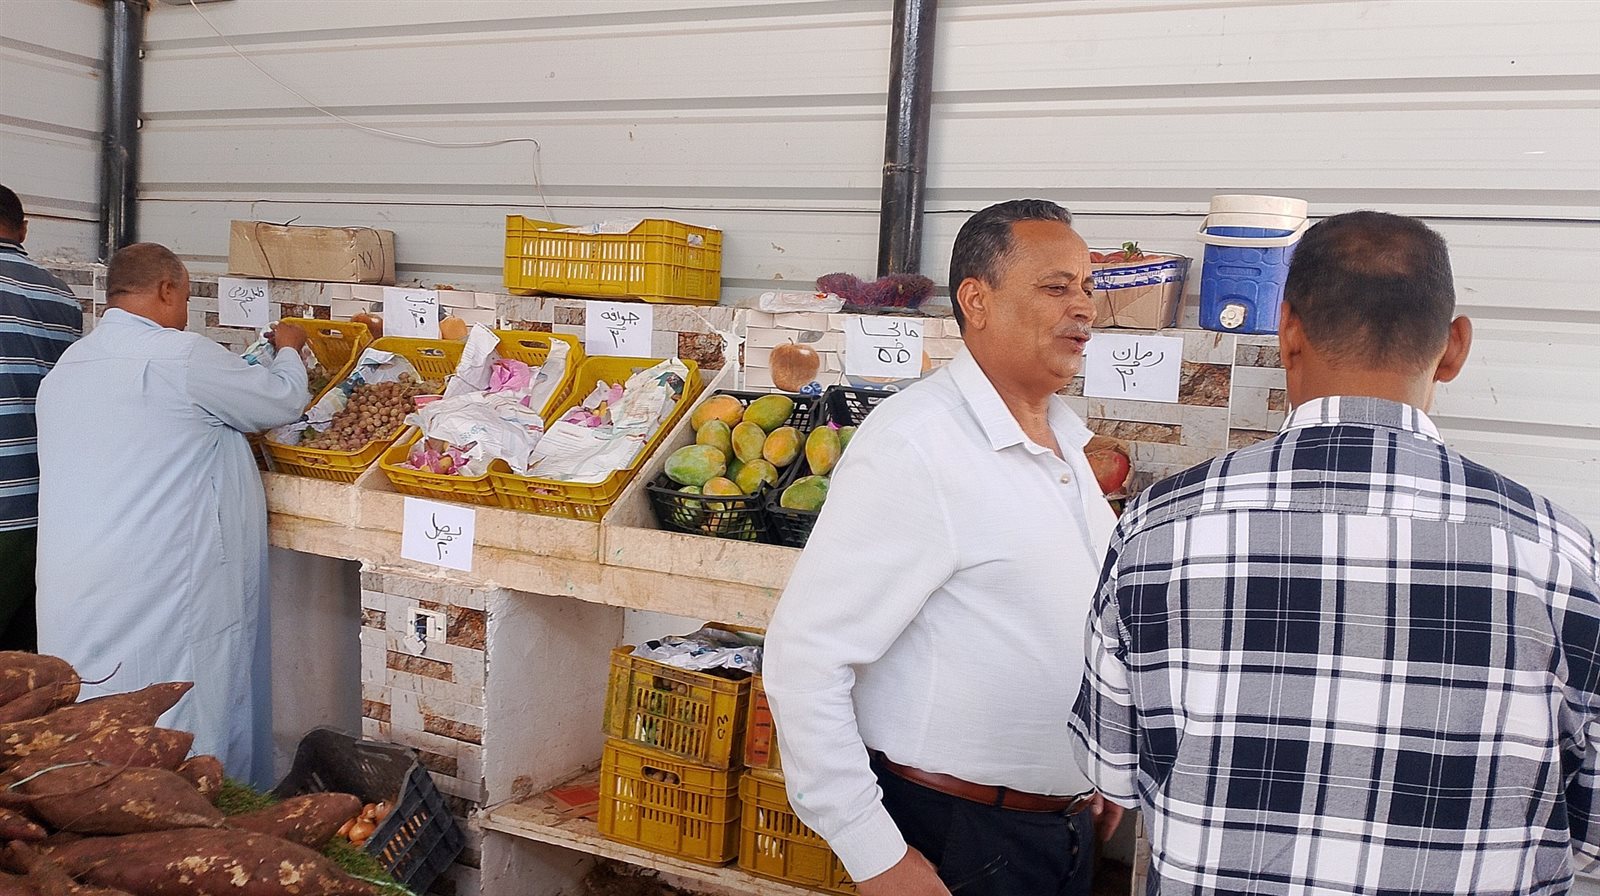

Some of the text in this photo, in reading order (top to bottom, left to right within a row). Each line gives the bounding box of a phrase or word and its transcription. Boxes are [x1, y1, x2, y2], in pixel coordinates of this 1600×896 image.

[405, 295, 435, 306] عنب
[1112, 342, 1164, 367] رمان
[424, 512, 462, 540] بصل
